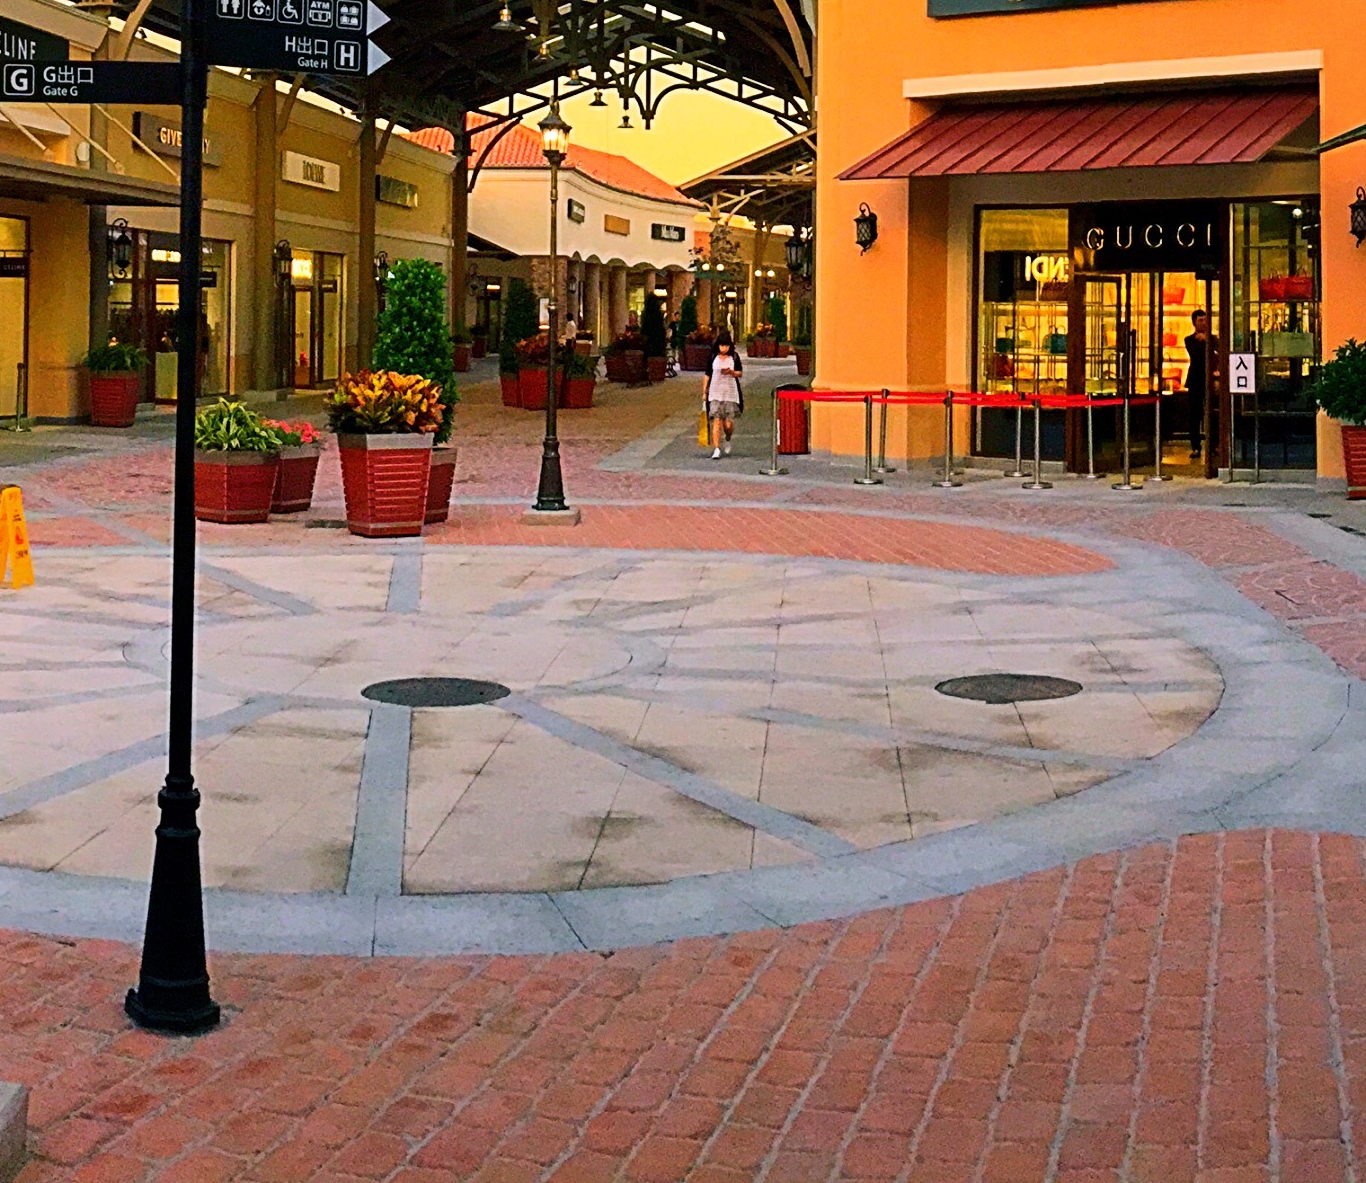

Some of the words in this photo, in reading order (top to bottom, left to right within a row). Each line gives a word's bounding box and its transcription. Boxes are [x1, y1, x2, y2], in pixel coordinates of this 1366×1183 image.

[310, 0, 330, 10] ATM
[285, 35, 329, 55] H出口
[339, 44, 355, 67] H
[297, 56, 319, 69] Gate
[321, 59, 328, 69] H
[10, 68, 29, 92] G
[43, 65, 94, 85] G出口
[43, 85, 68, 97] Gate
[70, 86, 79, 97] G
[160, 127, 211, 155] GIVEY
[1085, 223, 1212, 251] GUCCI
[1235, 356, 1248, 388] 入口
